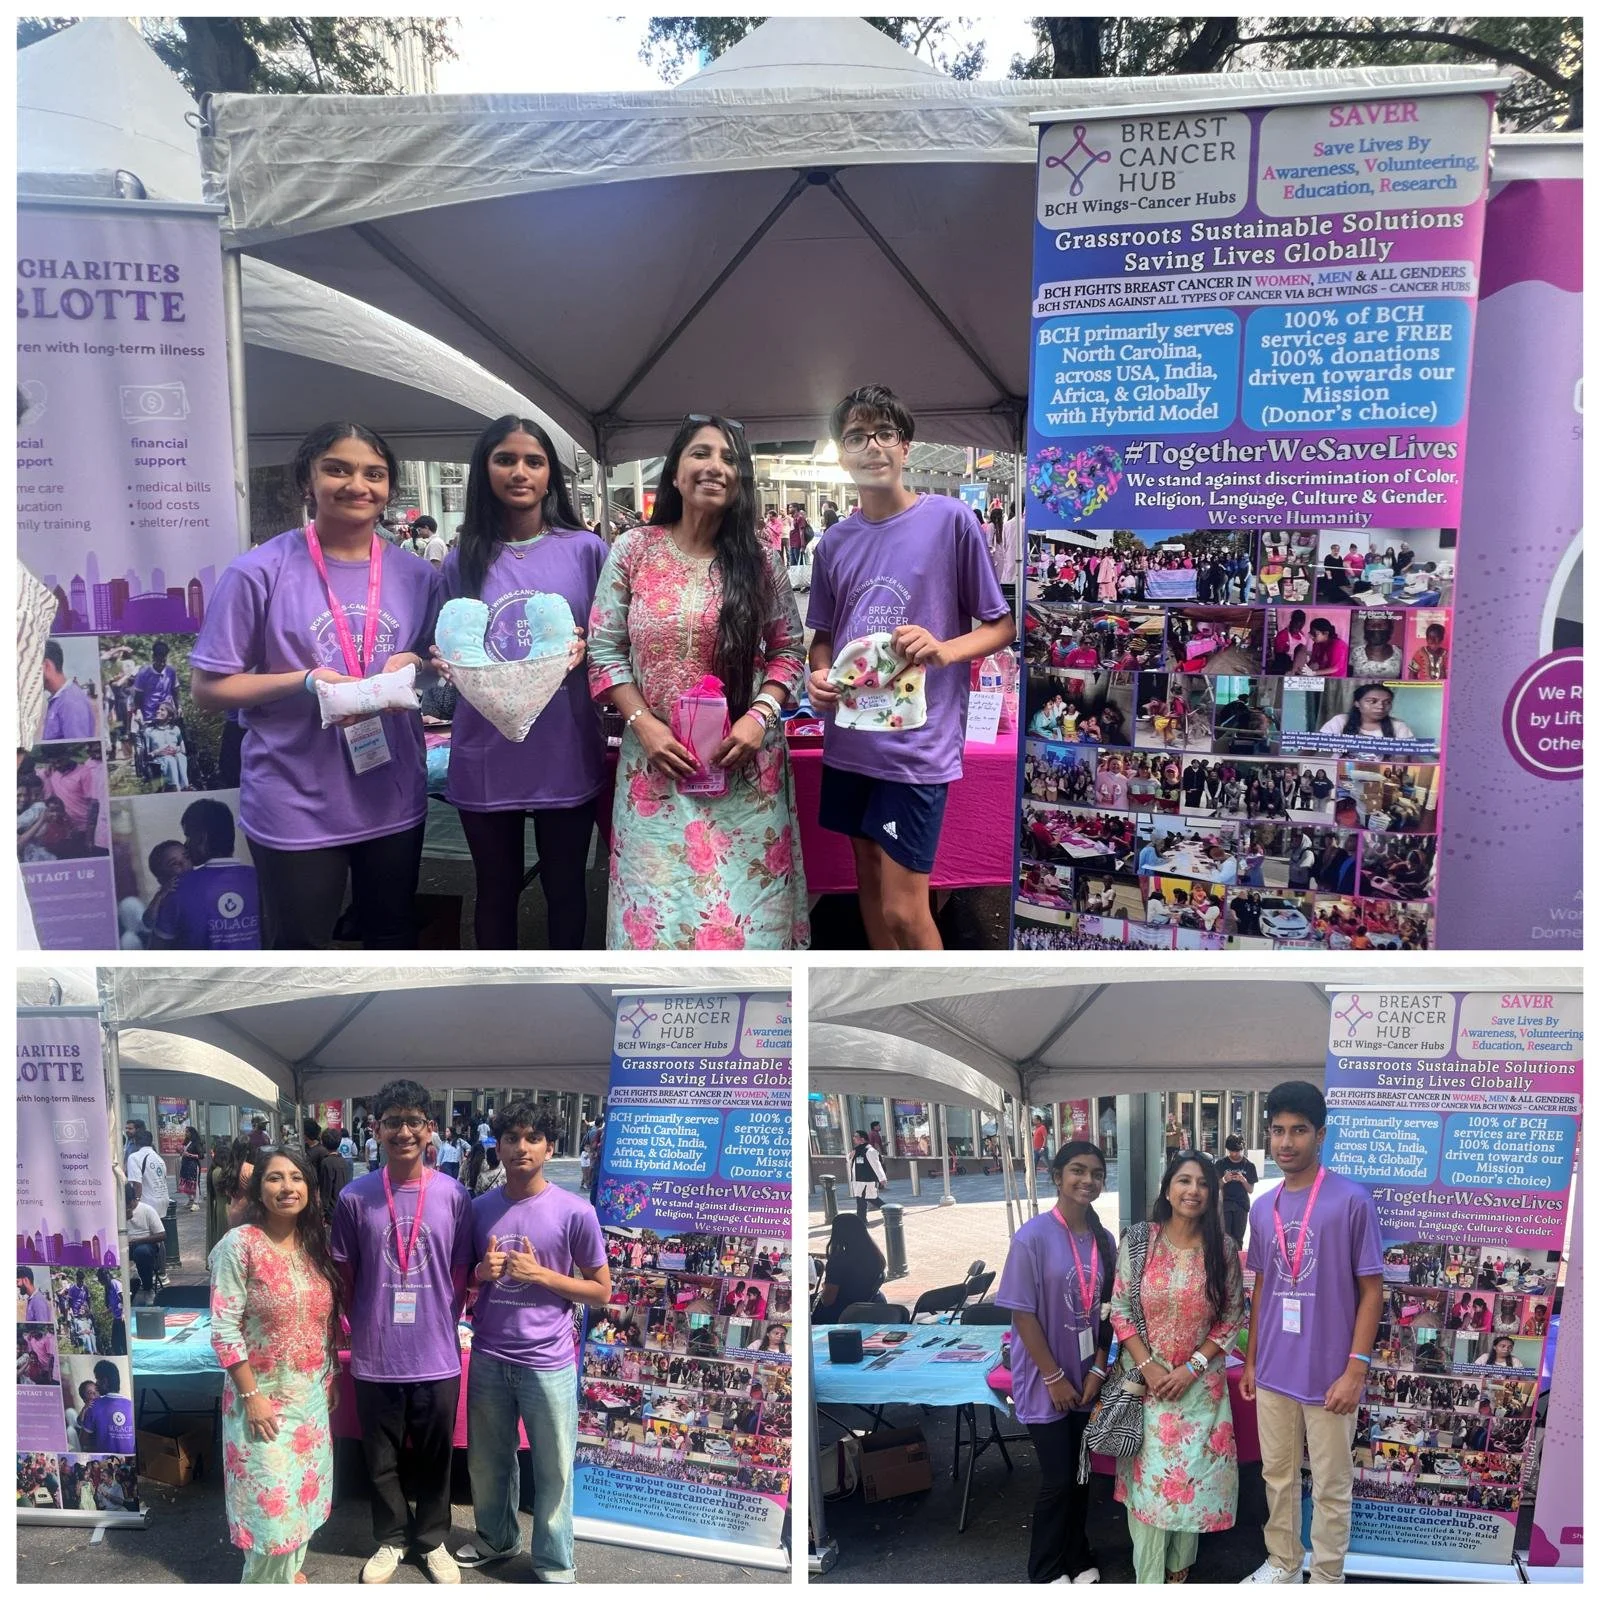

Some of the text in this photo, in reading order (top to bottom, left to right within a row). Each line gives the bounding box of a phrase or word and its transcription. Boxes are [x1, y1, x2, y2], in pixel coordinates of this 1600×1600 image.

[1329, 102, 1418, 127] SAVER
[1122, 117, 1227, 143] BREAST
[1120, 142, 1236, 167] CANCER
[1314, 136, 1432, 157] Save Lives By
[1263, 154, 1480, 182] Awareness, Volunteering,
[1119, 171, 1176, 193] HUB
[1284, 175, 1458, 200] Education, Research
[1045, 203, 1077, 217] BCH
[1196, 191, 1236, 205] Hubs
[1055, 210, 1464, 251] Grassroots Sustainable Solutions
[1124, 237, 1394, 273] Saving Lives Globally
[18, 258, 180, 283] CHARITIES
[1044, 267, 1466, 299] BCH FIGHTS BREAST CANCER IN WOMEN, MEN & ALL GENDERS
[1038, 303, 1060, 312] BCH
[1062, 300, 1105, 310] STANDS
[1108, 297, 1156, 307] AGAINST
[1158, 295, 1179, 304] ALL
[1181, 293, 1217, 303] TYPES
[1219, 292, 1234, 300] OF
[1236, 288, 1281, 300] CANCER
[1285, 290, 1304, 298] VIA
[1308, 288, 1332, 297] BCH
[1336, 285, 1378, 295] WINGS
[1389, 283, 1438, 293] CANCER
[1441, 282, 1471, 291] HUBS
[1285, 305, 1425, 328] 100% of BCH
[1039, 322, 1234, 346] BCH primarily serves
[1261, 324, 1453, 348] services are FREE
[45, 341, 79, 354] with
[83, 343, 156, 357] long-term
[160, 343, 205, 357] illness
[1062, 343, 1202, 363] North Carolina,
[1272, 346, 1440, 366] 100% donations
[1055, 362, 1217, 384] across USA, India,
[1249, 364, 1455, 386] driven towards our
[1051, 384, 1212, 405] Africa, & Globally
[1302, 386, 1390, 403] Mission
[1046, 403, 1219, 427] with Hybrid Model
[1359, 401, 1438, 422] choice)
[131, 437, 188, 448] financial
[1124, 434, 1458, 471] #TogetherWeSaveLives
[134, 457, 186, 468] support
[39, 484, 64, 493] care
[136, 482, 211, 492] medical bills
[1127, 469, 1459, 489] We stand against discrimination of Color,
[137, 499, 200, 510] food costs
[1135, 489, 1448, 510] Religion, Language, Culture & Gender.
[44, 519, 91, 532] training
[138, 517, 210, 528] shelter/rent
[1208, 510, 1372, 527] We serve Humanity
[866, 616, 909, 625] CANCER
[868, 606, 906, 615] BREAST
[1538, 686, 1566, 700] We
[1530, 712, 1551, 729] by
[1538, 736, 1583, 751] Othe
[208, 916, 258, 930] SOLACE
[664, 996, 728, 1010] BREAST
[1379, 995, 1443, 1008] BREAST
[1501, 994, 1554, 1009] SAVER
[662, 1012, 730, 1024] CANCER
[1377, 1011, 1446, 1024] CANCER
[1491, 1016, 1560, 1027] Save Lives By
[660, 1027, 695, 1039] HUB
[1377, 1026, 1411, 1039] HUB
[1461, 1028, 1517, 1040] Awareness,
[618, 1042, 636, 1050] BCH
[704, 1041, 728, 1049] Hubs
[1472, 1041, 1573, 1052] Education, Research
[1372, 1187, 1563, 1211] #TogetherWeSaveLives
[584, 1475, 768, 1516] Visit: www.breastcancerhub.org
[592, 1467, 763, 1504] To learn about our Global impact
